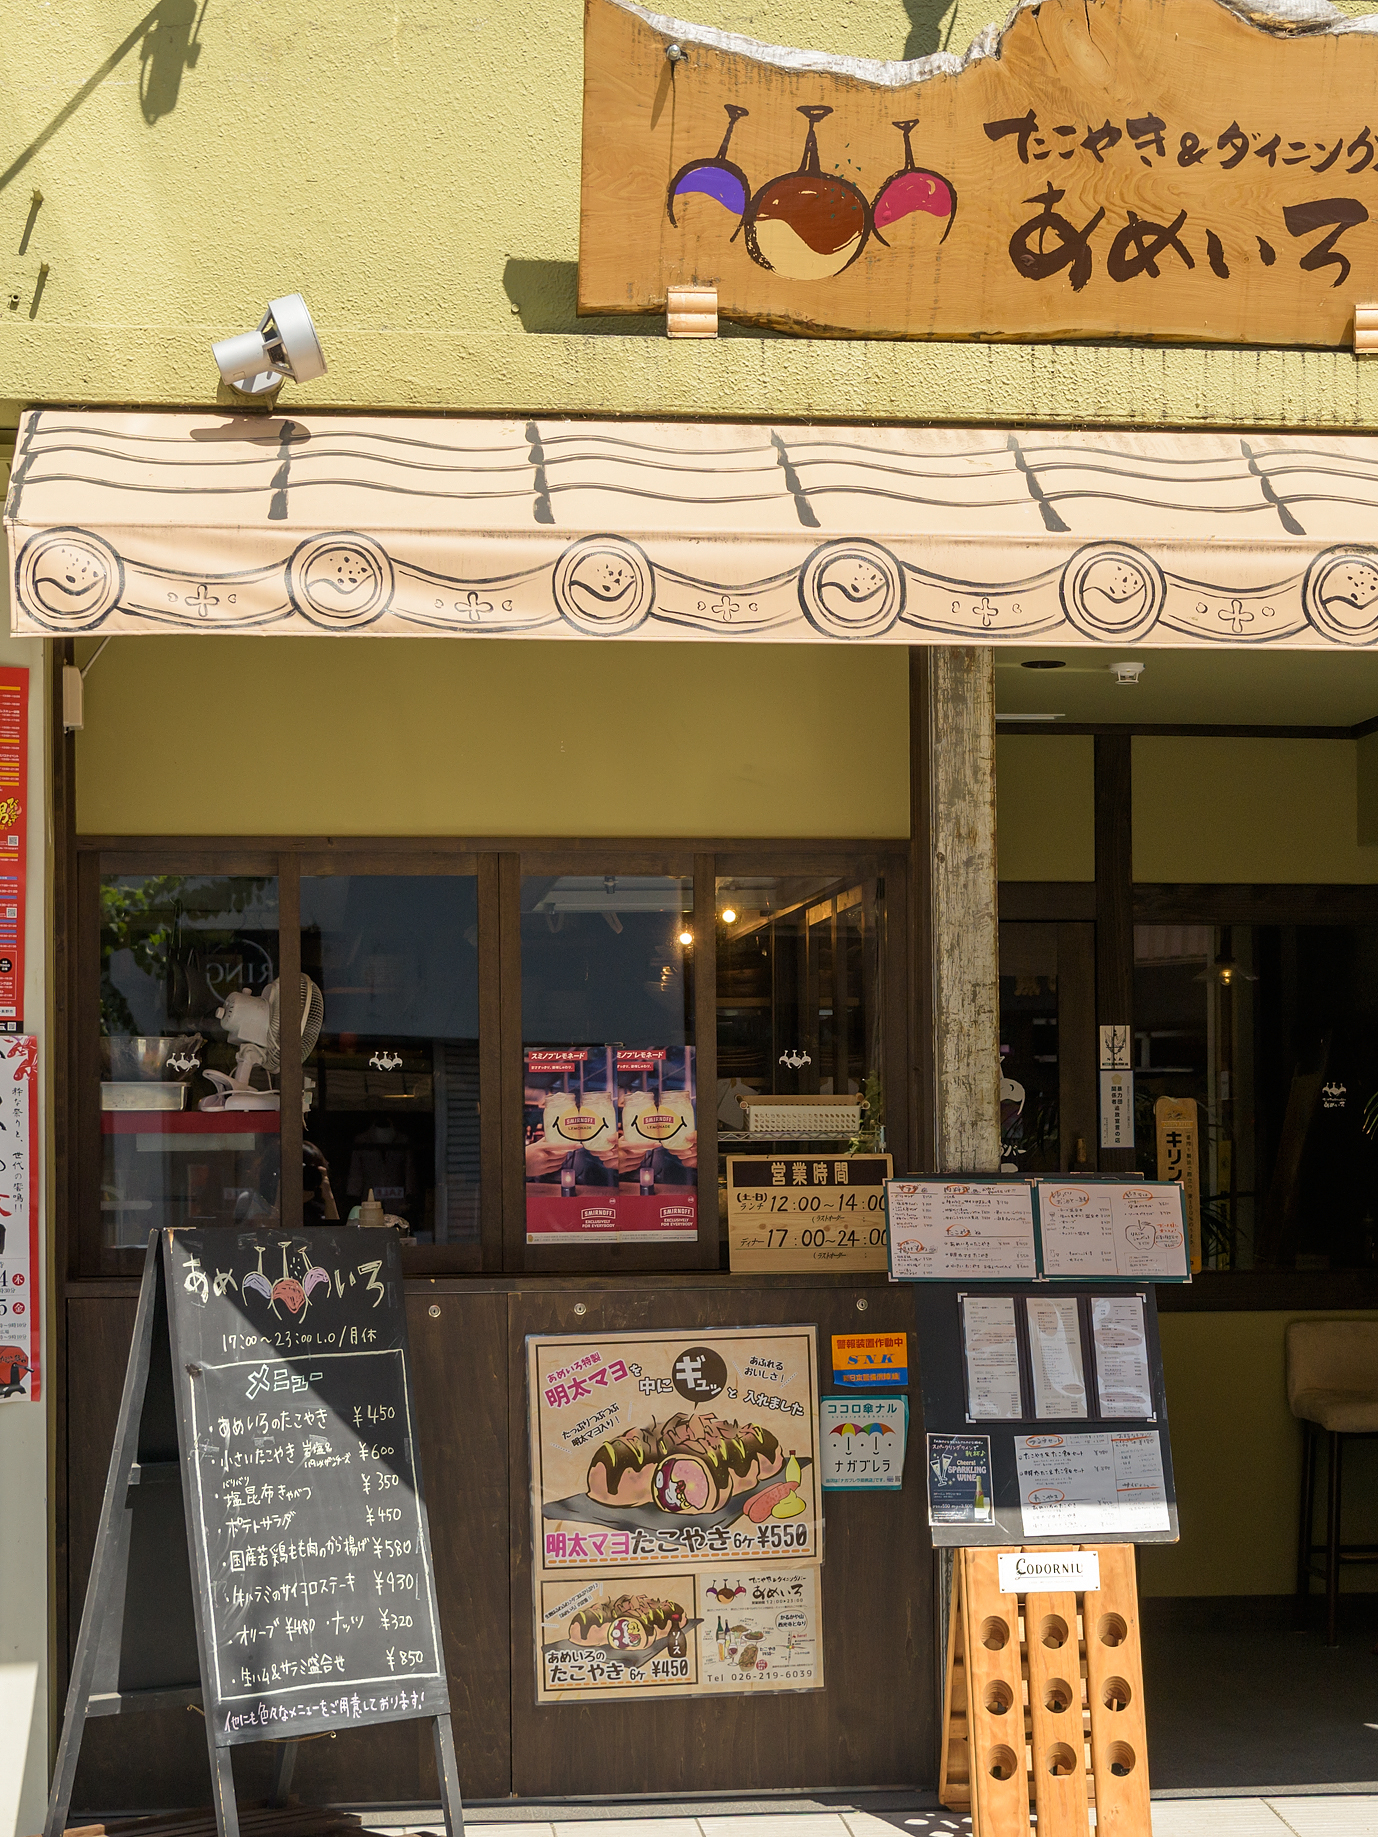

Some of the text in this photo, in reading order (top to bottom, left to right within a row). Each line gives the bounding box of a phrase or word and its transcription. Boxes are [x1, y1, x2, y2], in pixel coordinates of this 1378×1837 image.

[1009, 181, 1369, 292] あめいろ
[566, 1117, 594, 1125] SMIRNOFF
[771, 1162, 849, 1185] 営業時間
[740, 1203, 764, 1211] ランチ
[740, 1238, 764, 1247] ディナー
[837, 1338, 903, 1349] 警報装置作動中
[547, 1352, 601, 1383] あめいろ特製
[749, 1356, 783, 1371] あふれる
[246, 1364, 323, 1400] メニュー
[544, 1360, 629, 1408] 明太マヨ
[639, 1376, 673, 1396] 中に
[676, 1355, 722, 1395] ギュッ
[744, 1389, 805, 1416] 入れました
[353, 1405, 395, 1427] ¥450
[828, 1403, 898, 1414] ココロ傘ナル
[562, 1403, 620, 1440] たっぷりつぶつぶ
[358, 1441, 395, 1461] ¥600
[835, 1460, 890, 1473] ナガブレラ
[361, 1472, 399, 1495] ¥350
[226, 1505, 402, 1537] ポテトサラダ ¥450
[373, 1537, 412, 1558] ¥580
[757, 1524, 808, 1548] ¥550
[373, 1570, 414, 1595] ¥930
[753, 1584, 803, 1600] あめいろ
[237, 1608, 413, 1646] オリーブ ¥480 ナッツ ¥320
[673, 1631, 681, 1655] ソース
[386, 1646, 423, 1671] ¥850
[548, 1650, 605, 1664] あめいろの
[551, 1663, 624, 1683] たこやき
[652, 1659, 688, 1678] ¥450
[707, 1670, 812, 1682] Tel 026-219-6039
